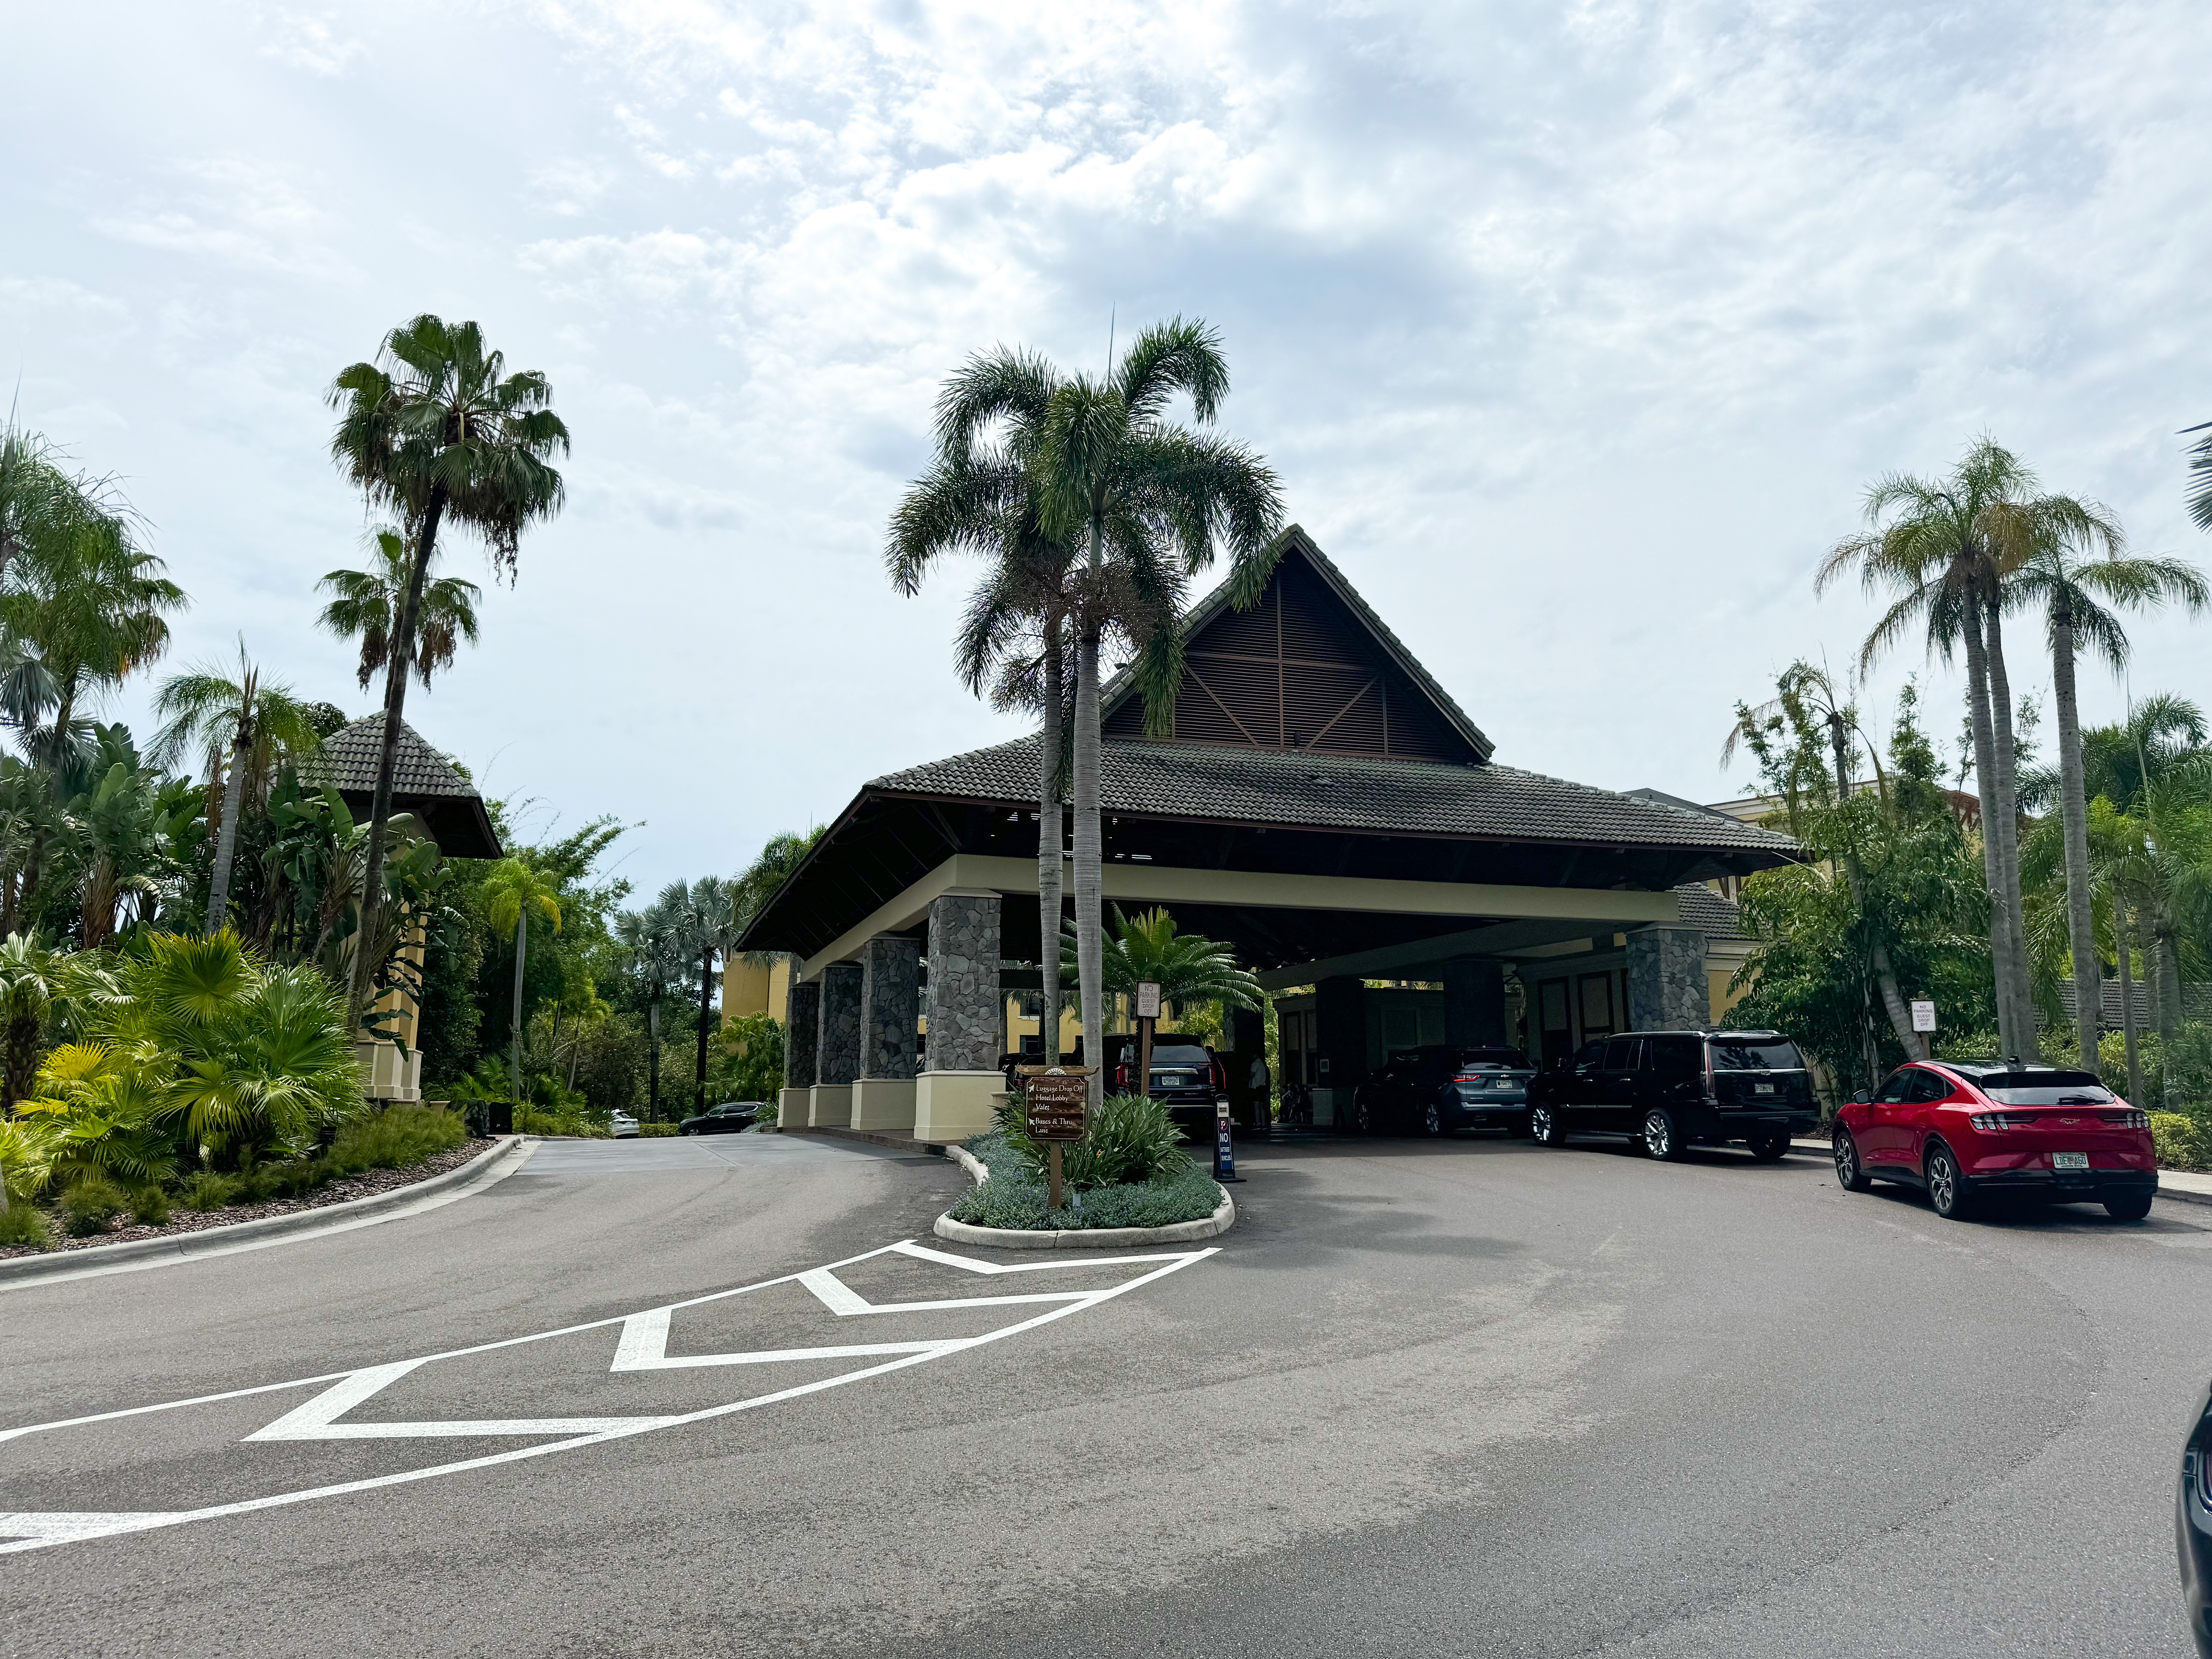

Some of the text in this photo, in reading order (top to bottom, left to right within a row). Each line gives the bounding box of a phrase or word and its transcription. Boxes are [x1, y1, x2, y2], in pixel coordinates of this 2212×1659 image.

[1036, 1084, 1058, 1093] Luggage
[1073, 1085, 1084, 1093] Off
[1053, 1094, 1069, 1102] Lobby
[1220, 1133, 1228, 1142] NO
